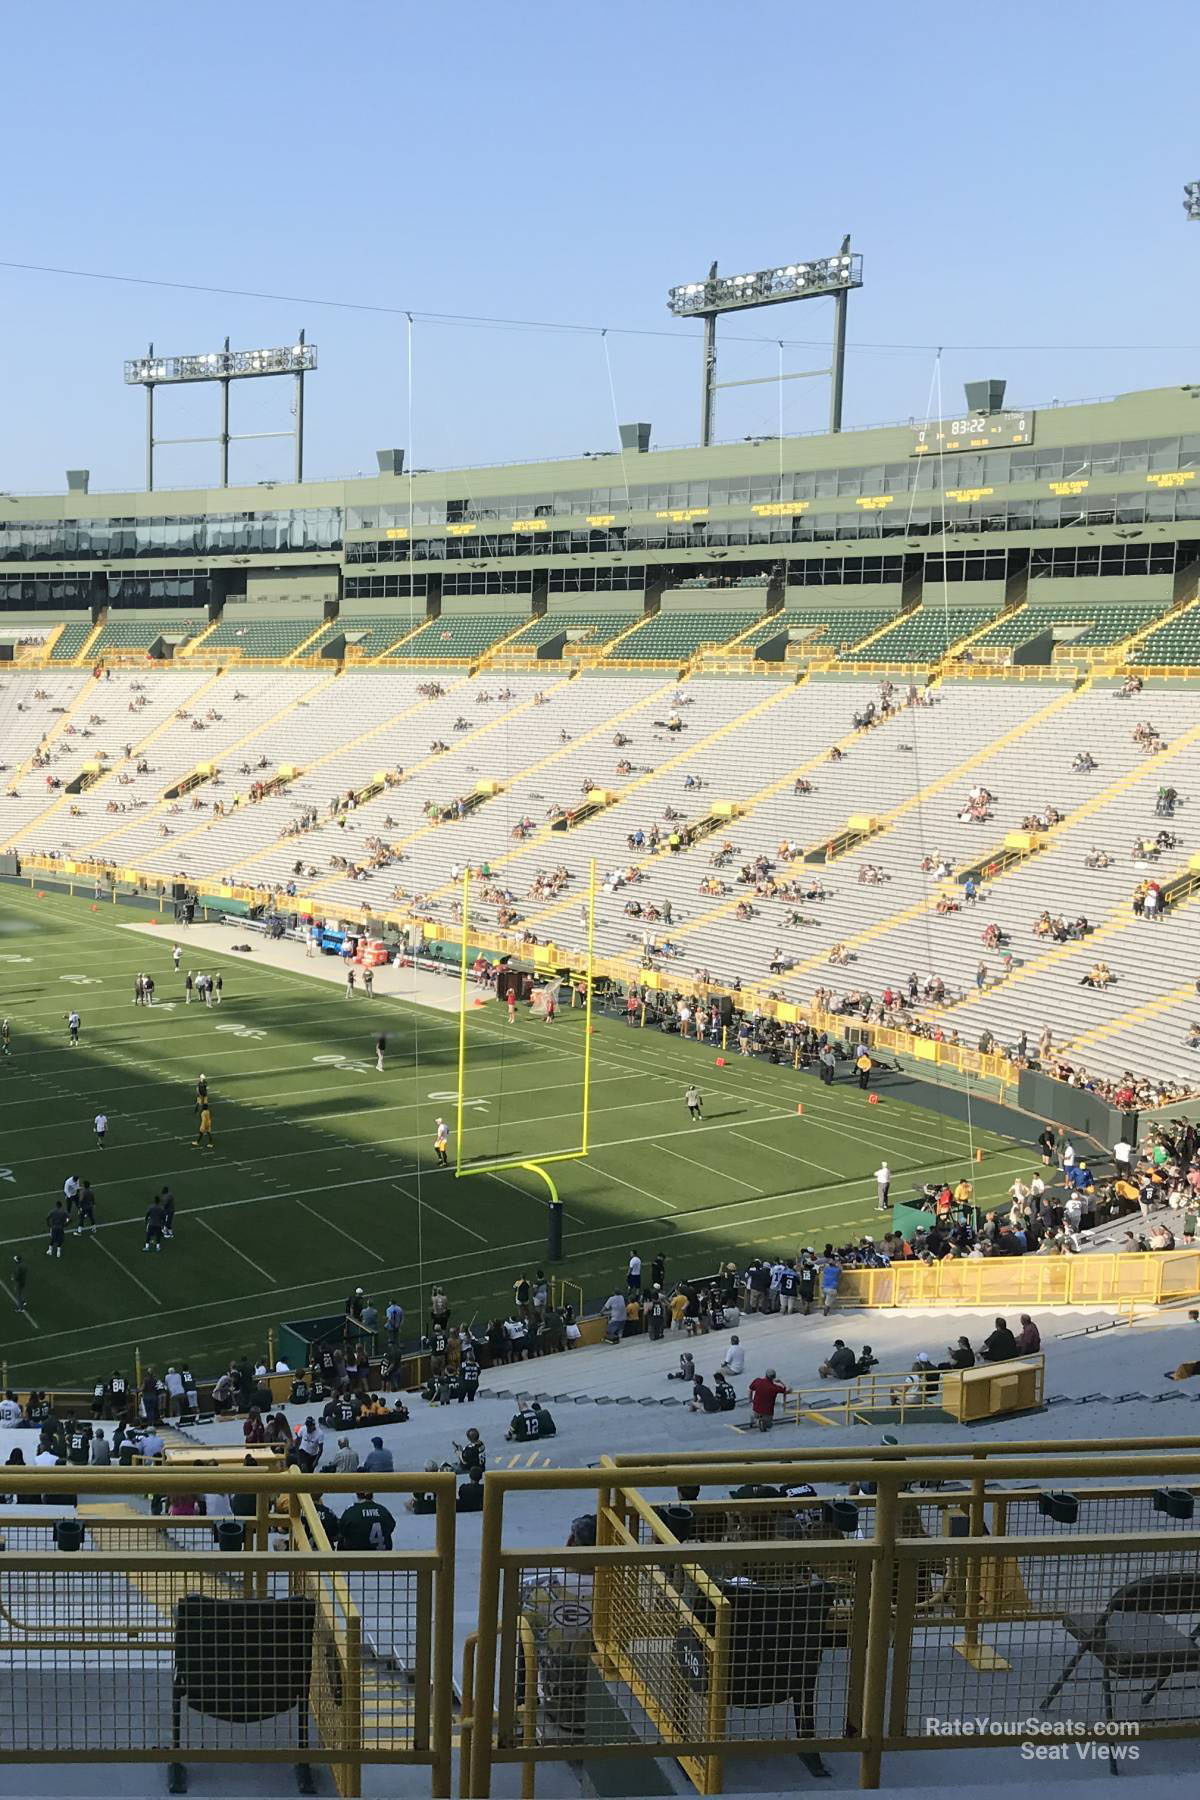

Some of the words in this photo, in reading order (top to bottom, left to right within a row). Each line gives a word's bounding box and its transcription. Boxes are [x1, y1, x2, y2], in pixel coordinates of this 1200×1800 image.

[951, 418, 986, 435] 83:22
[1019, 419, 1026, 431] 0
[919, 431, 926, 442] 0
[436, 1340, 445, 1351] 18
[183, 1374, 193, 1382] 12
[112, 1380, 125, 1393] 84
[1, 1409, 12, 1421] 12
[341, 1409, 353, 1420] 12
[525, 1418, 539, 1436] 12
[71, 1438, 82, 1449] 21
[361, 1509, 380, 1517] FAVRE
[369, 1522, 386, 1546] 4
